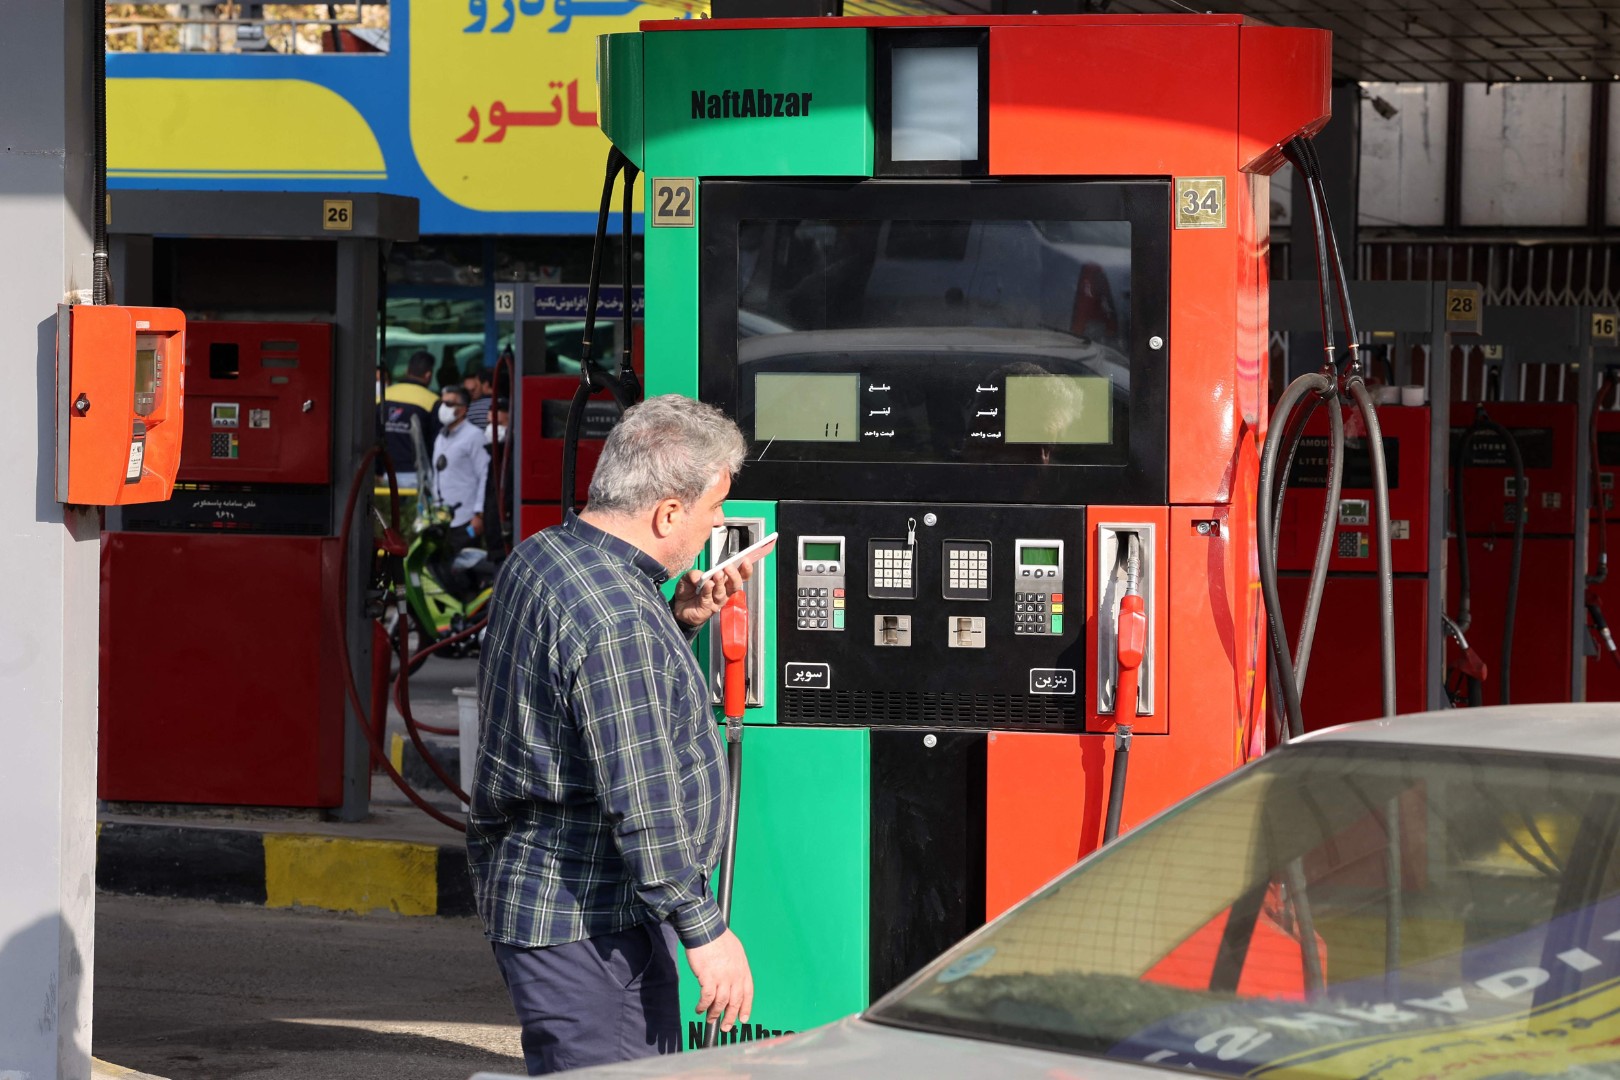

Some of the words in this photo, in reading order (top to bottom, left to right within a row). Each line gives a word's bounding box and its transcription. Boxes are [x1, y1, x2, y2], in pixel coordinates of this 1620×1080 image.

[455, 78, 598, 143] اتور
[691, 88, 813, 119] NaftAbzar
[657, 186, 691, 217] 22
[1182, 188, 1219, 215] 34
[327, 207, 348, 222] 26
[497, 294, 511, 309] 13
[1451, 297, 1473, 312] 28
[1594, 319, 1613, 334] 16
[868, 383, 891, 393] مبلغ
[975, 384, 998, 393] مبلغ
[868, 406, 891, 416] لیتر
[975, 408, 998, 417] لیتر
[864, 429, 880, 438] واحد
[880, 429, 895, 437] قیمت
[792, 670, 823, 682] سوپر
[1034, 675, 1068, 689] بنزین
